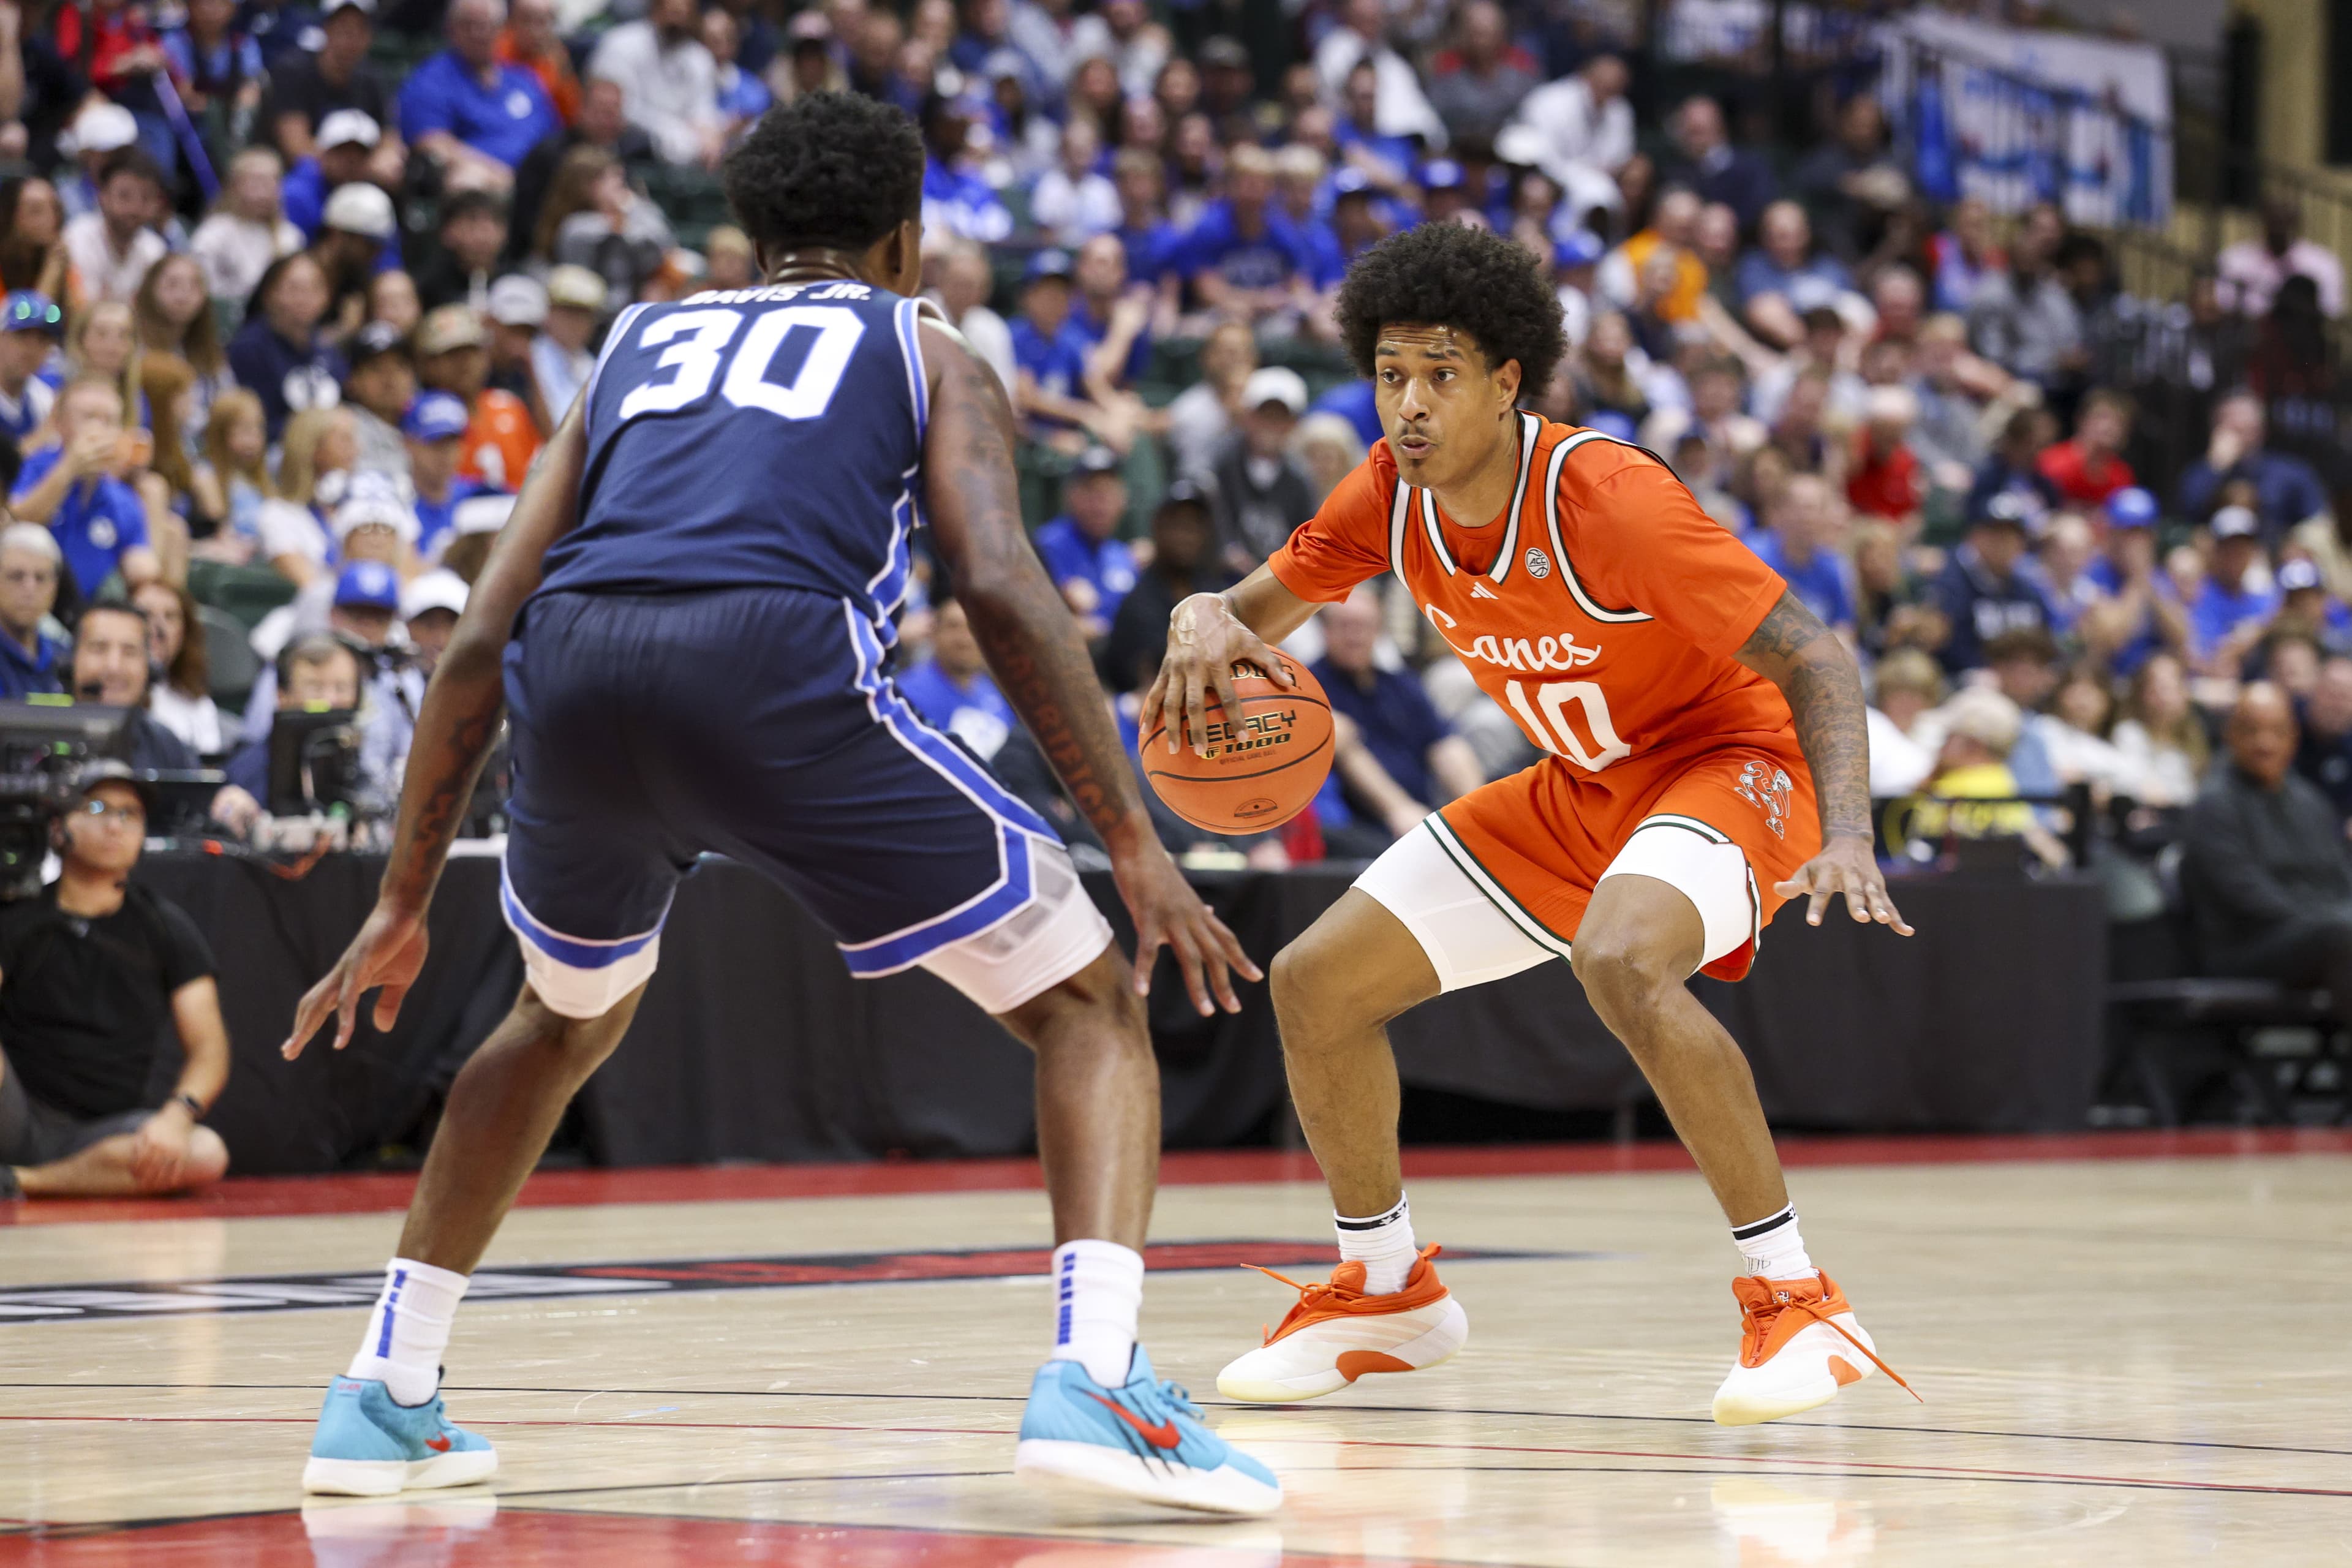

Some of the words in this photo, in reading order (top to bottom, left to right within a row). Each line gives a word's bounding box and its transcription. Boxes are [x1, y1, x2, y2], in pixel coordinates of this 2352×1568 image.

[680, 285, 806, 306] DAVIS
[808, 284, 871, 300] JR.
[619, 306, 867, 420] 30
[1425, 603, 1602, 671] Canes
[1225, 733, 1291, 754] 1000
[1505, 679, 1631, 772] 10
